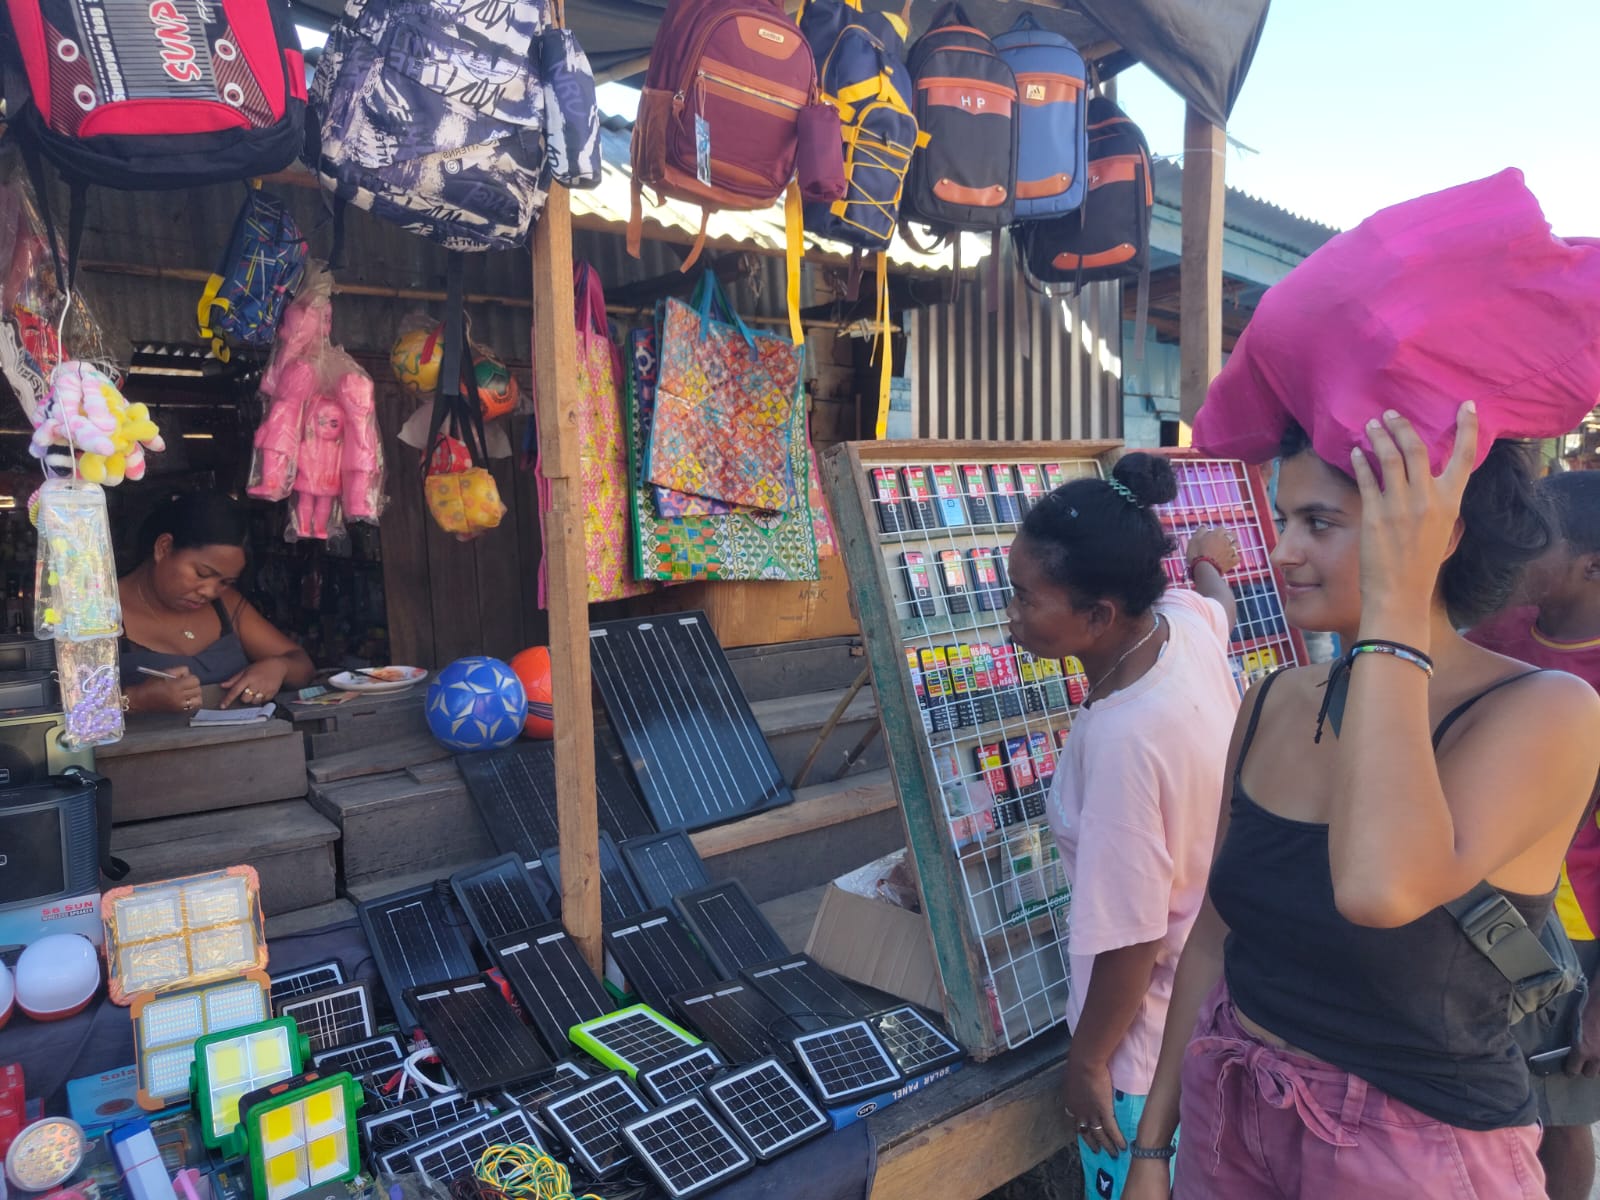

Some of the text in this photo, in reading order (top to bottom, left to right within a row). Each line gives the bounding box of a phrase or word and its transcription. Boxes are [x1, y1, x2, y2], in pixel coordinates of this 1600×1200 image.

[89, 7, 126, 102] Sunpower bag
[149, 0, 202, 82] SUNP
[64, 901, 93, 912] SUN
[100, 1069, 137, 1081] Sola
[892, 1066, 950, 1100] SOLAR PANEL
